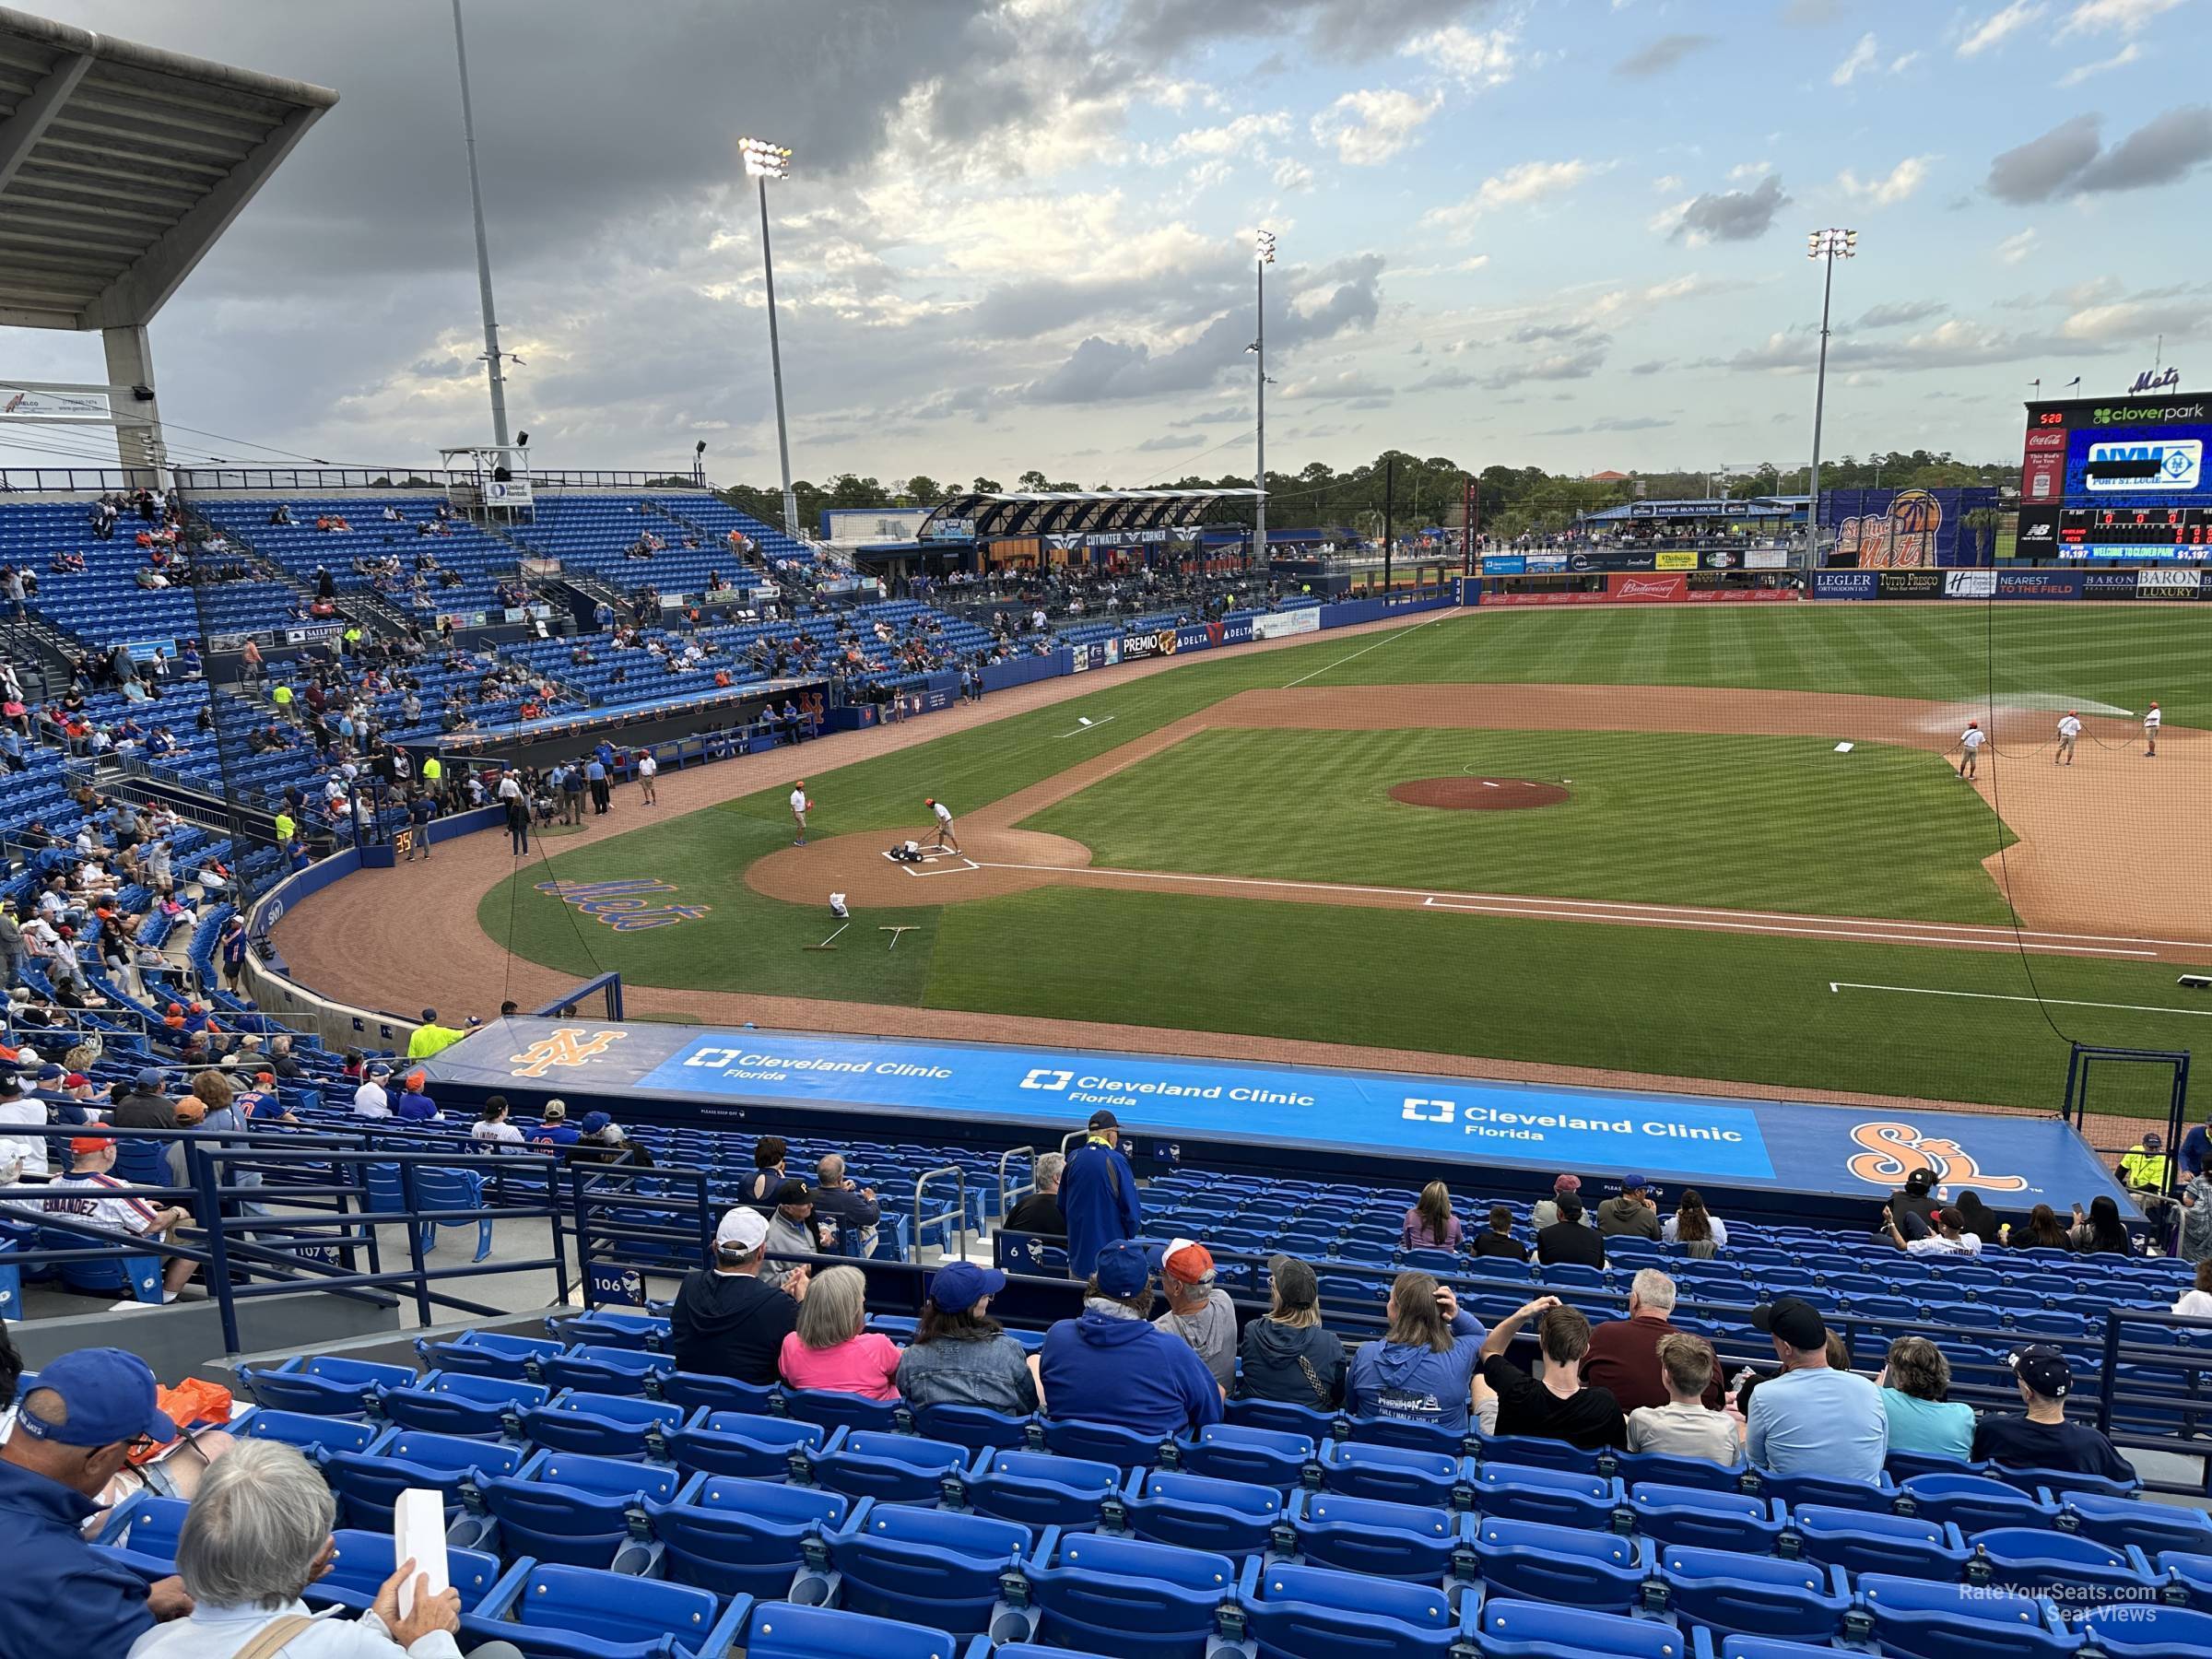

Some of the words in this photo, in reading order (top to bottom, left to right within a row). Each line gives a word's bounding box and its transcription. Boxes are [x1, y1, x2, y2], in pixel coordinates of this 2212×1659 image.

[2128, 367, 2179, 394] Mets
[2041, 413, 2062, 424] 5:28
[2093, 477, 2117, 486] PORT
[2134, 476, 2162, 484] LUCIE
[1086, 533, 1121, 546] CUTWATER
[1141, 530, 1166, 542] CORNER
[1858, 535, 1923, 568] Mets
[2059, 550, 2089, 559] $1,197
[2093, 547, 2123, 557] WELCOME
[2125, 547, 2132, 557] TO
[2133, 547, 2156, 557] CLOVER
[2157, 547, 2174, 557] PARK
[2177, 550, 2210, 560] $1,197
[1817, 575, 1871, 586] LEGLER
[2000, 577, 2049, 585] NEAREST
[2086, 576, 2134, 584] BARON
[2140, 571, 2199, 585] BARON
[1624, 582, 1673, 594] Budweiser
[2143, 587, 2192, 597] LUXURY
[1231, 627, 1252, 638] DELTA
[1124, 635, 1157, 653] PREMIO
[1184, 634, 1208, 645] DELTA
[533, 879, 712, 932] Mets
[738, 1053, 874, 1075] Cleveland
[875, 1062, 953, 1079] Clinic
[723, 1068, 787, 1082] Florida
[1077, 1076, 1221, 1100] Cleveland
[1229, 1087, 1316, 1107] Clinic
[1068, 1092, 1137, 1107] Florida
[1464, 1107, 1633, 1134] Cleveland
[1642, 1121, 1743, 1142] Clinic
[1464, 1125, 1544, 1142] Florida
[800, 1183, 807, 1194] P
[43, 1198, 98, 1217] ERNANDEZ
[300, 1247, 320, 1257] 107
[1011, 1247, 1018, 1257] 6
[594, 1278, 621, 1292] 106
[2057, 1386, 2065, 1396] S
[26, 1421, 43, 1435] JAYS
